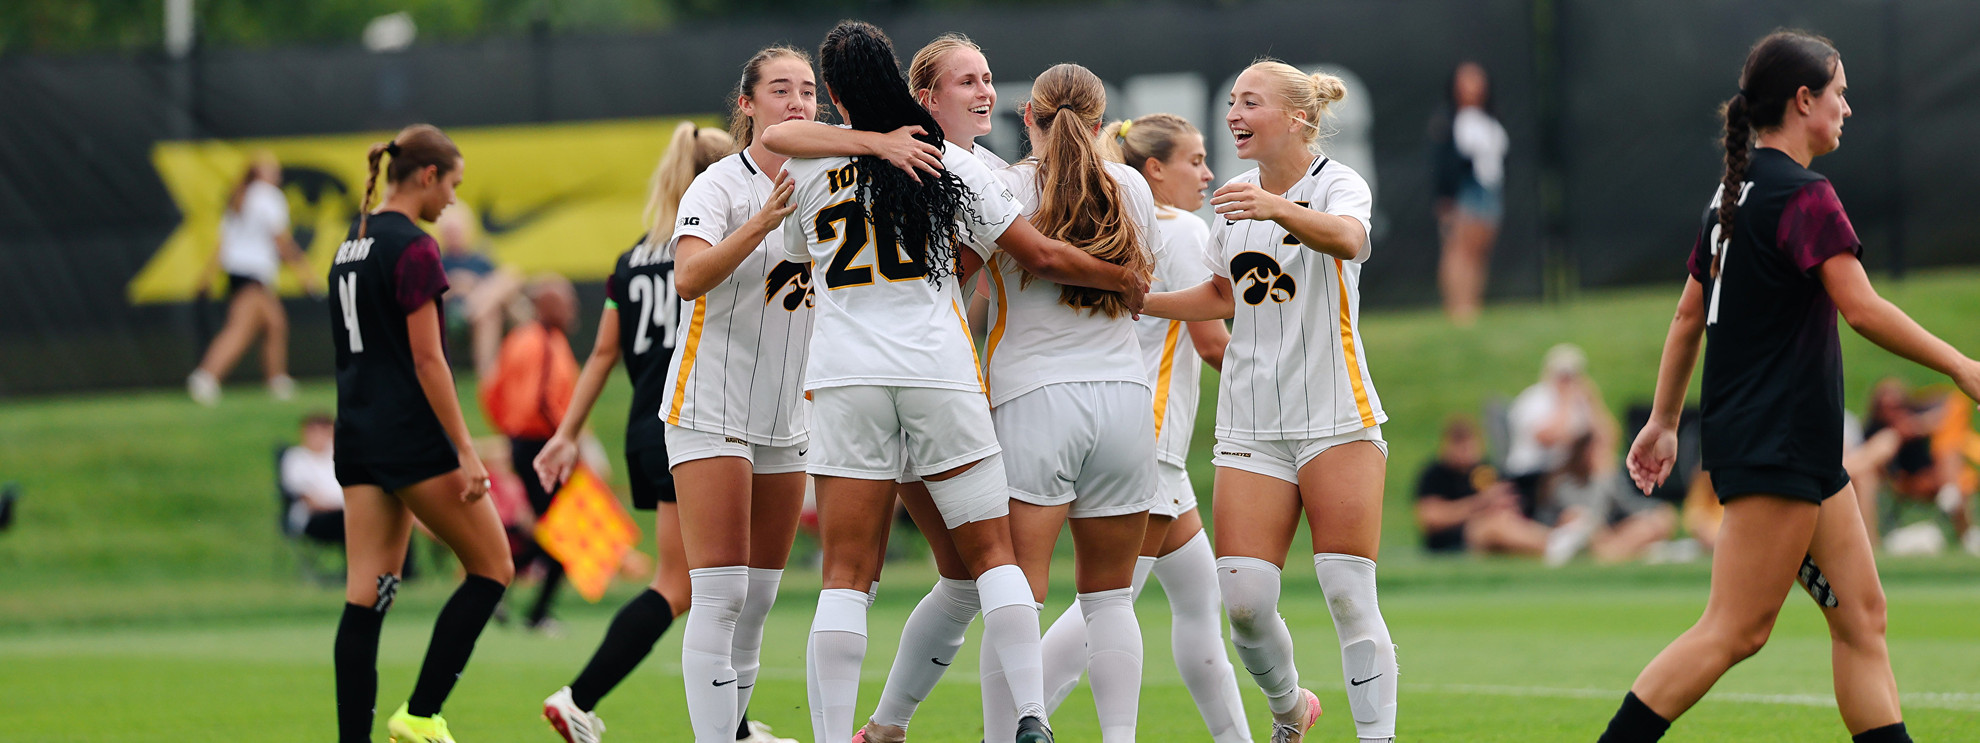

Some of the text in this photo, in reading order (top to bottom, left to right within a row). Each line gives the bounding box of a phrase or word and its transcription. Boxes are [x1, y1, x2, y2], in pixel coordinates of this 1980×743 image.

[814, 198, 929, 291] 20
[338, 271, 364, 353] 4
[628, 270, 678, 355] 24
